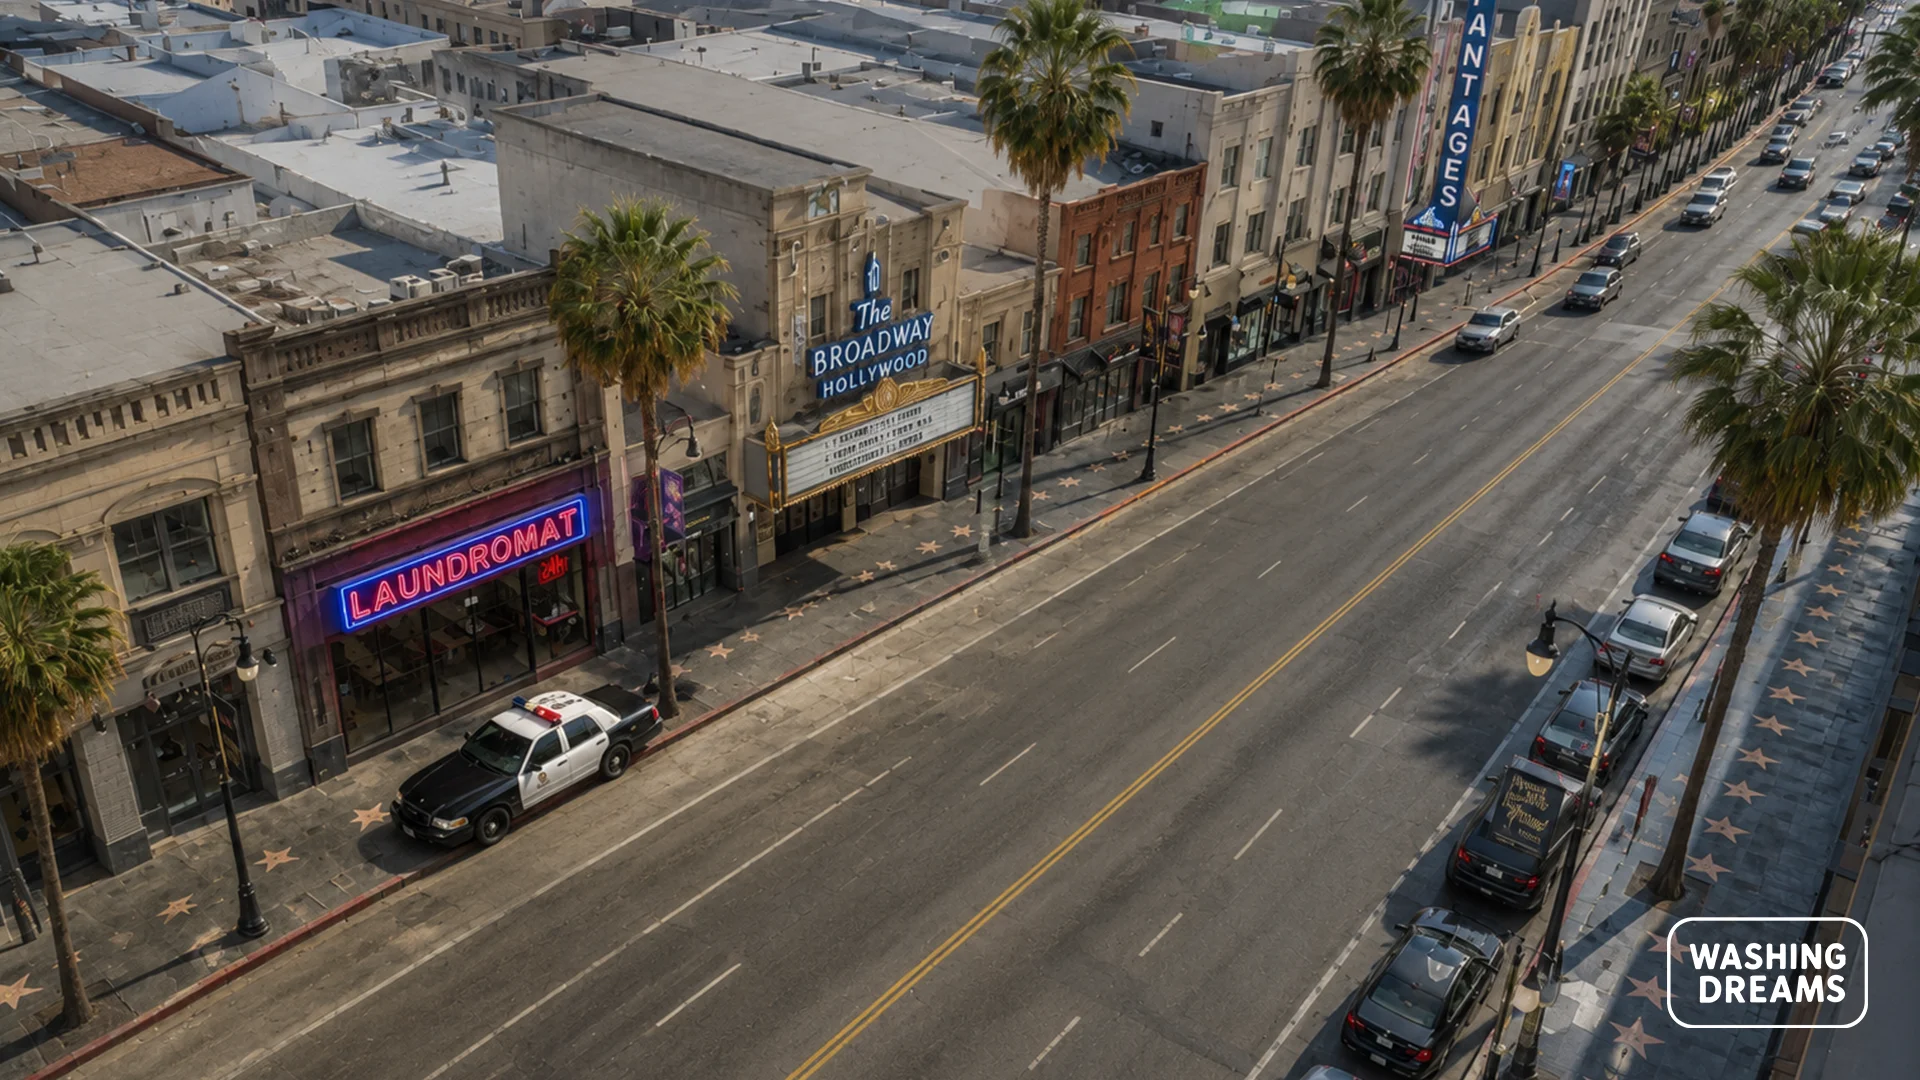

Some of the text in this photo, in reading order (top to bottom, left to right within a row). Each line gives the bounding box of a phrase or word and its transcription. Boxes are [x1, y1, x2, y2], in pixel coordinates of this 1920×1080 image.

[1440, 0, 1487, 207] ANTAGES
[857, 299, 891, 330] The
[814, 315, 934, 377] BROADWAY
[823, 349, 928, 399] HOLLYWOOD
[350, 508, 578, 619] LAUNDROMAT
